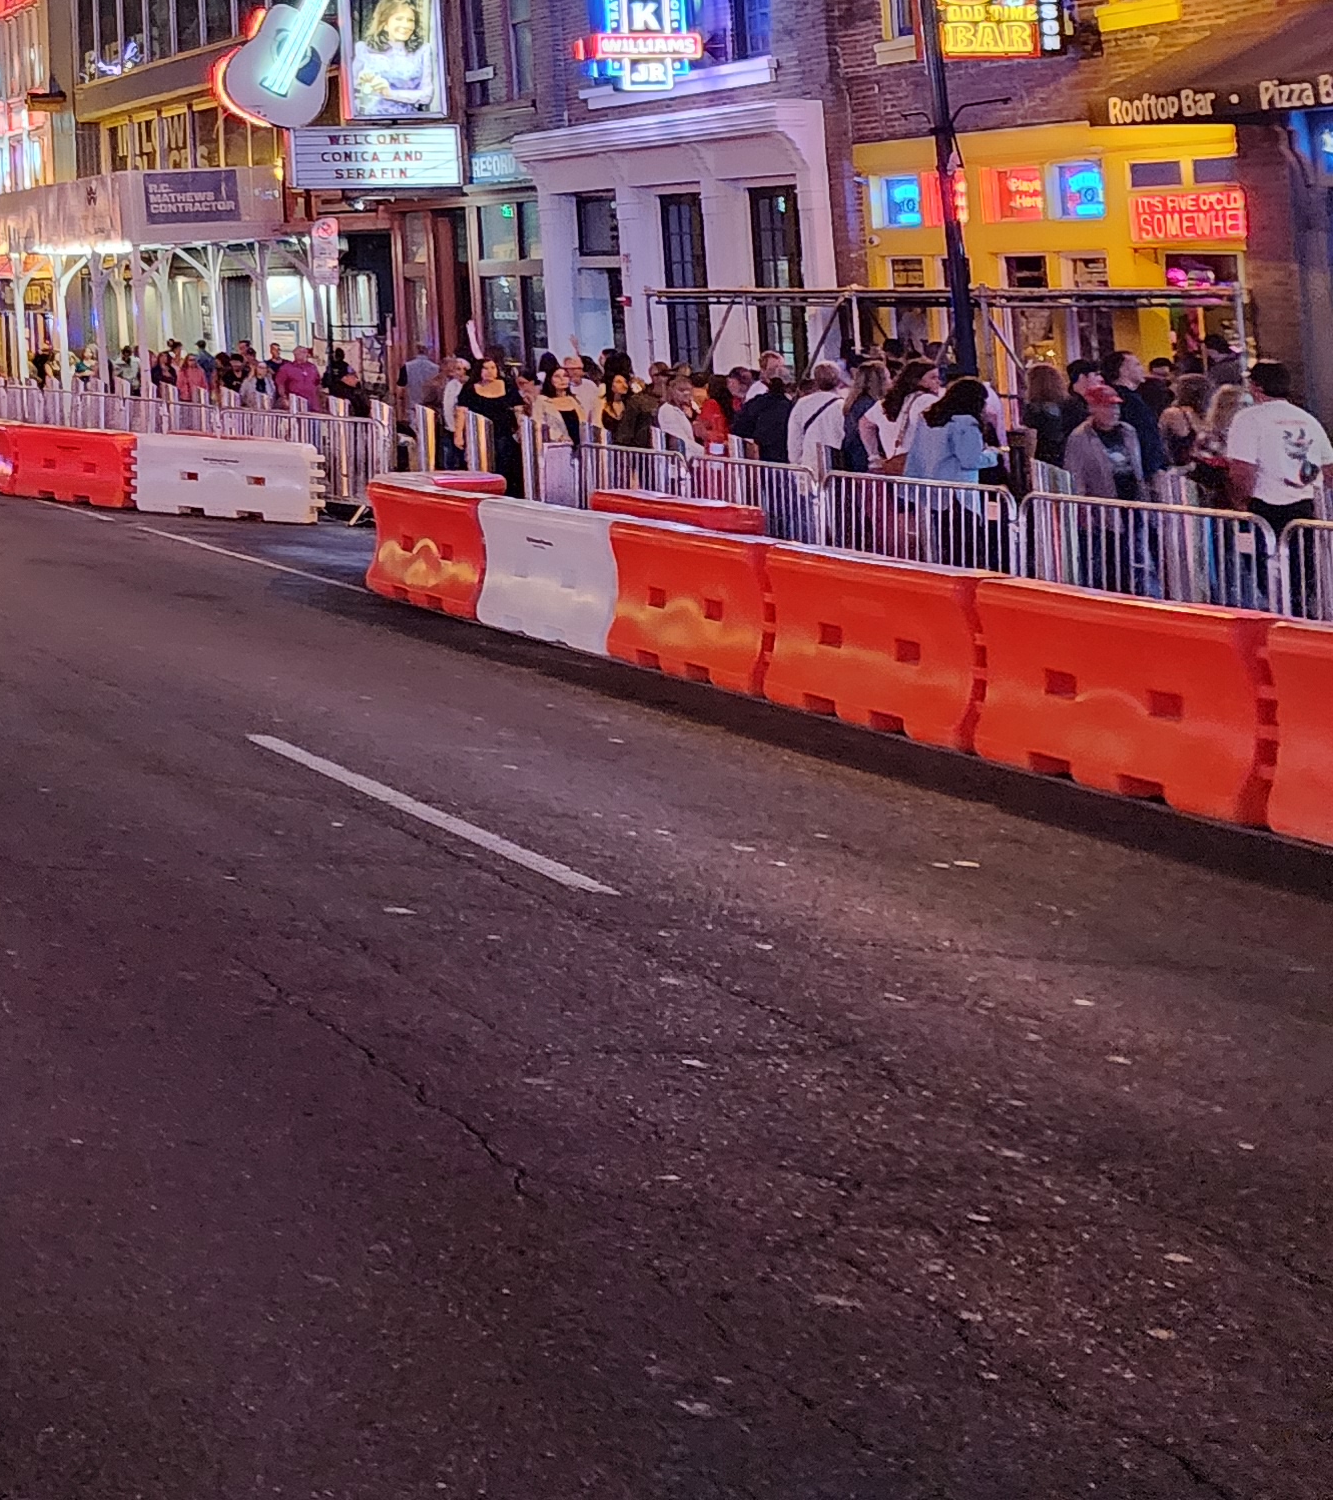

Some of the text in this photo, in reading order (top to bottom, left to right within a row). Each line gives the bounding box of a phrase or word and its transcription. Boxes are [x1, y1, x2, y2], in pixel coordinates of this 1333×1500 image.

[946, 3, 1039, 22] OOD TIME
[601, 37, 696, 54] WILLIAMS
[944, 22, 1033, 53] BAR
[631, 63, 667, 83] JR
[1108, 93, 1180, 124] Rooftop
[1180, 88, 1216, 117] Bar
[1259, 79, 1316, 110] Pizza
[327, 133, 411, 146] WELCOME
[320, 150, 424, 163] CONICA AND
[334, 167, 408, 180] SERAFIN
[472, 153, 515, 178] RECORD
[147, 182, 173, 194] R.C.
[148, 191, 216, 204] MATHEWS
[1137, 196, 1163, 213] IT'S
[1166, 195, 1198, 211] FIVE
[150, 200, 236, 213] CONTRACTOR
[1140, 210, 1242, 240] SOMEWHE
